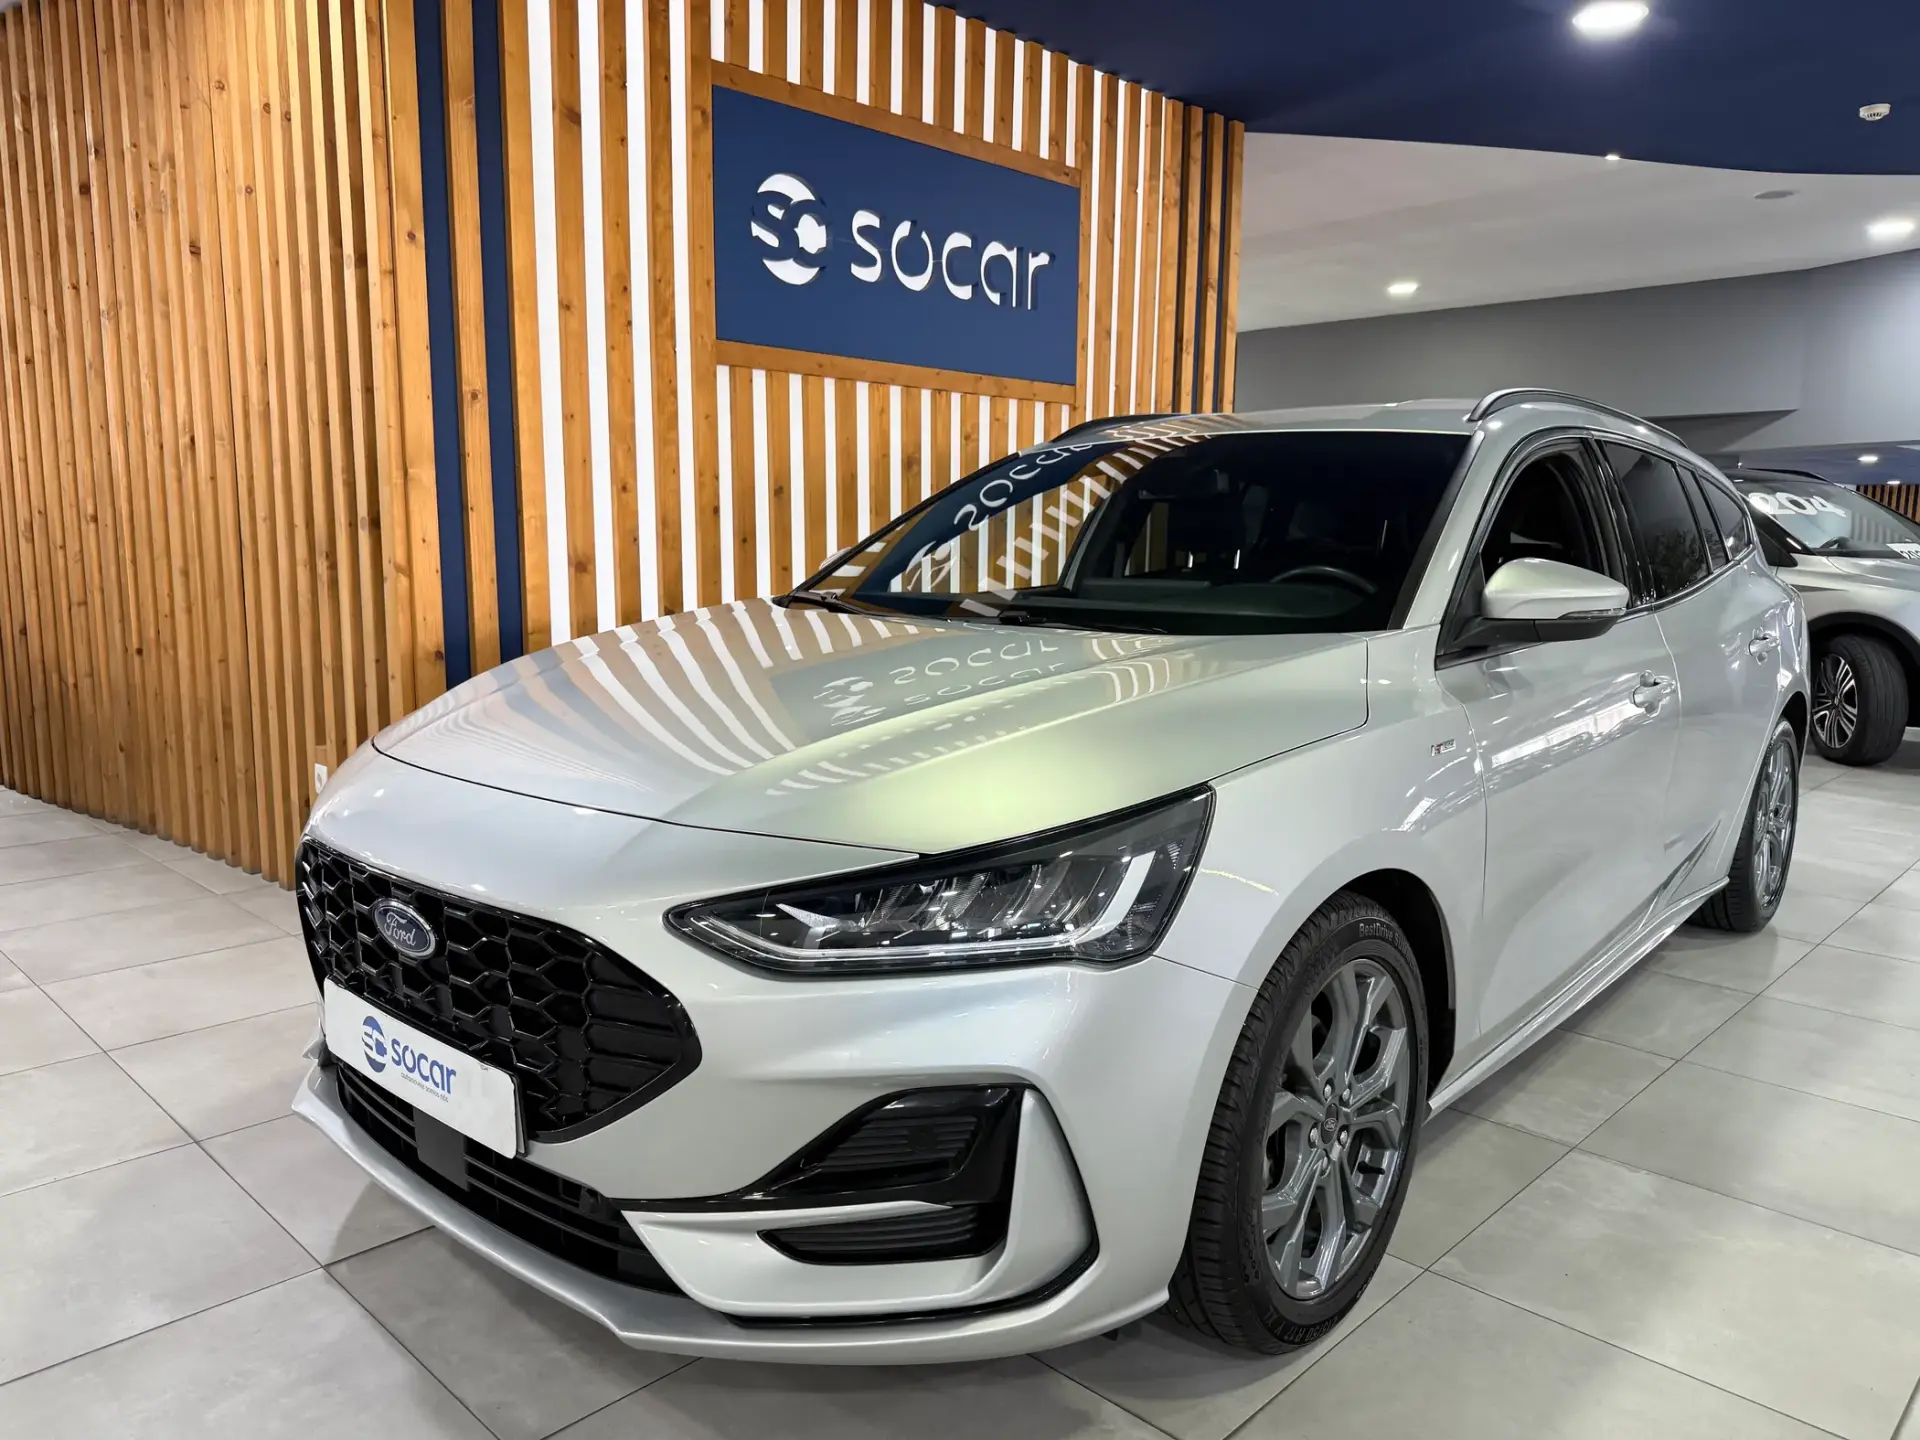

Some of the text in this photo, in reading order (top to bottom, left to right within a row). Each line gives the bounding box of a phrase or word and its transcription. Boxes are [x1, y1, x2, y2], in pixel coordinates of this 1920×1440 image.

[851, 209, 1050, 310] socar
[384, 911, 417, 946] Ford
[1359, 922, 1393, 941] BestDrive
[391, 1038, 457, 1095] socar
